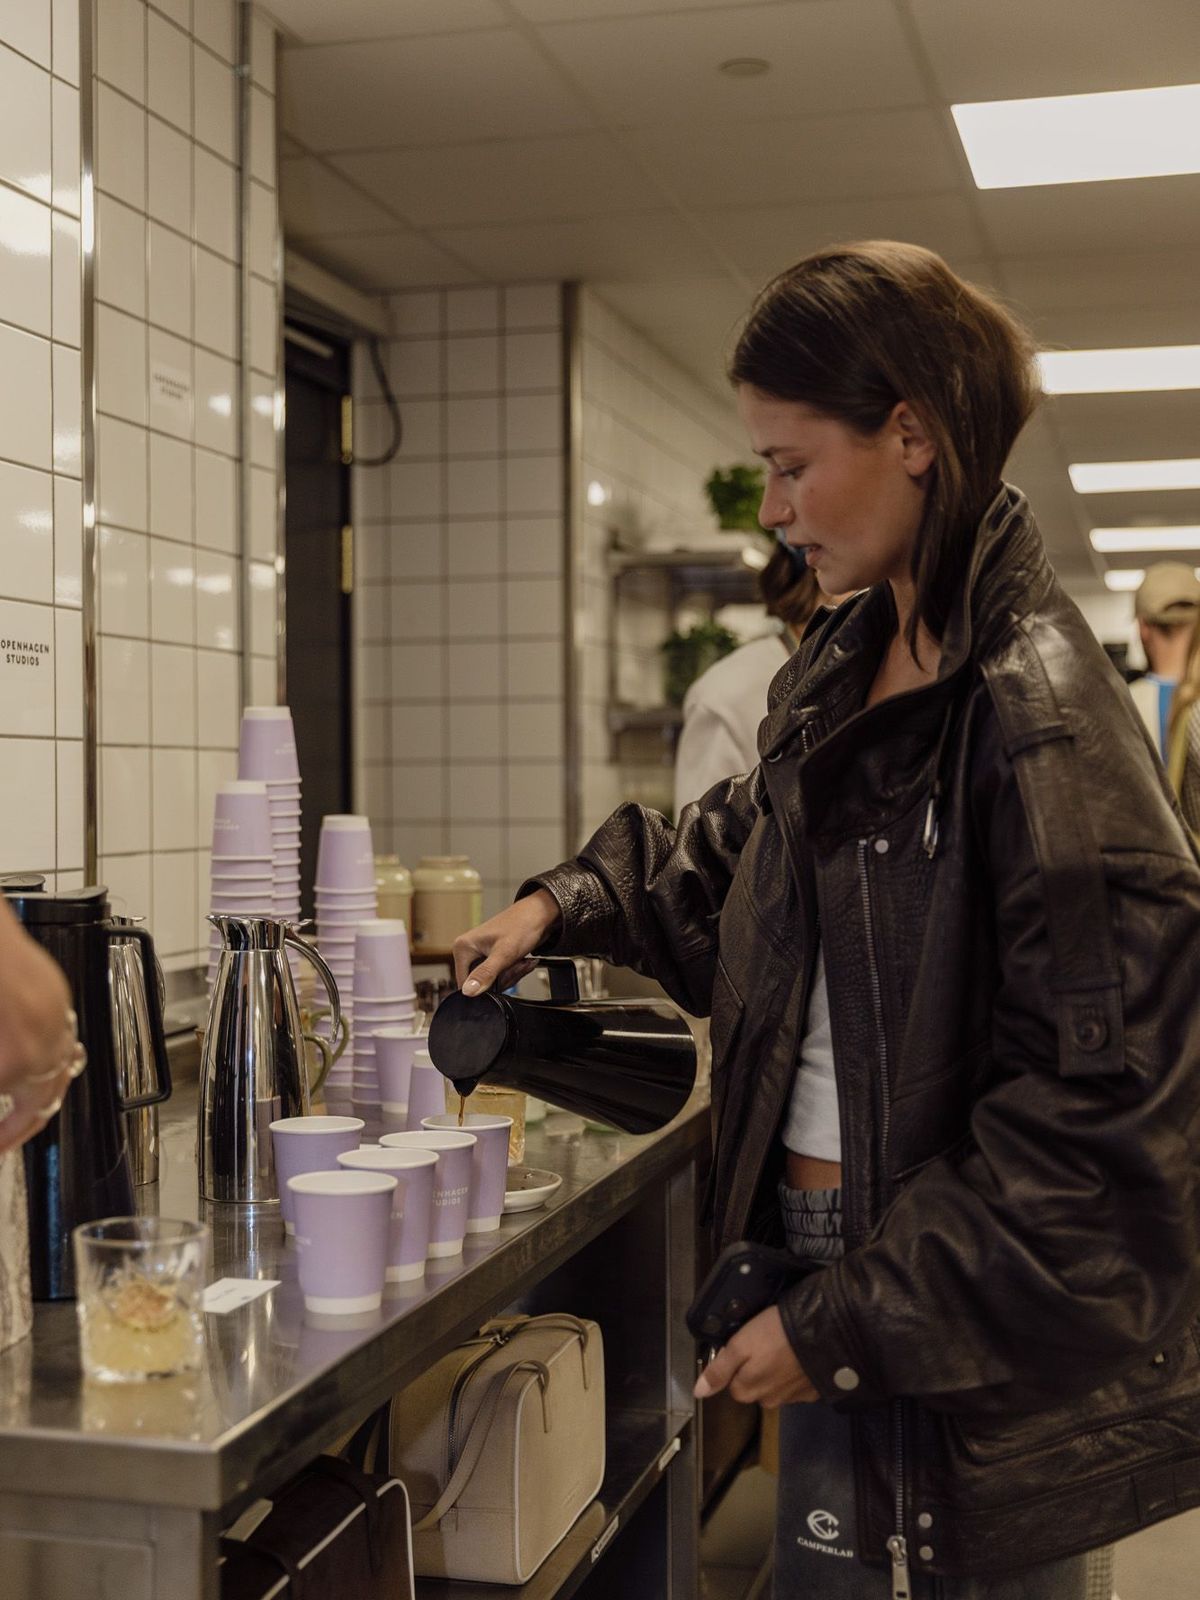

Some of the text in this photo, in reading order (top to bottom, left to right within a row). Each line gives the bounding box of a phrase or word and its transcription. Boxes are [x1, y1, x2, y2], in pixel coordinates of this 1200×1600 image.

[0, 639, 49, 654] OPENHAGEN
[6, 653, 40, 666] STUDIOS
[797, 1536, 854, 1558] CAMPERLAB
